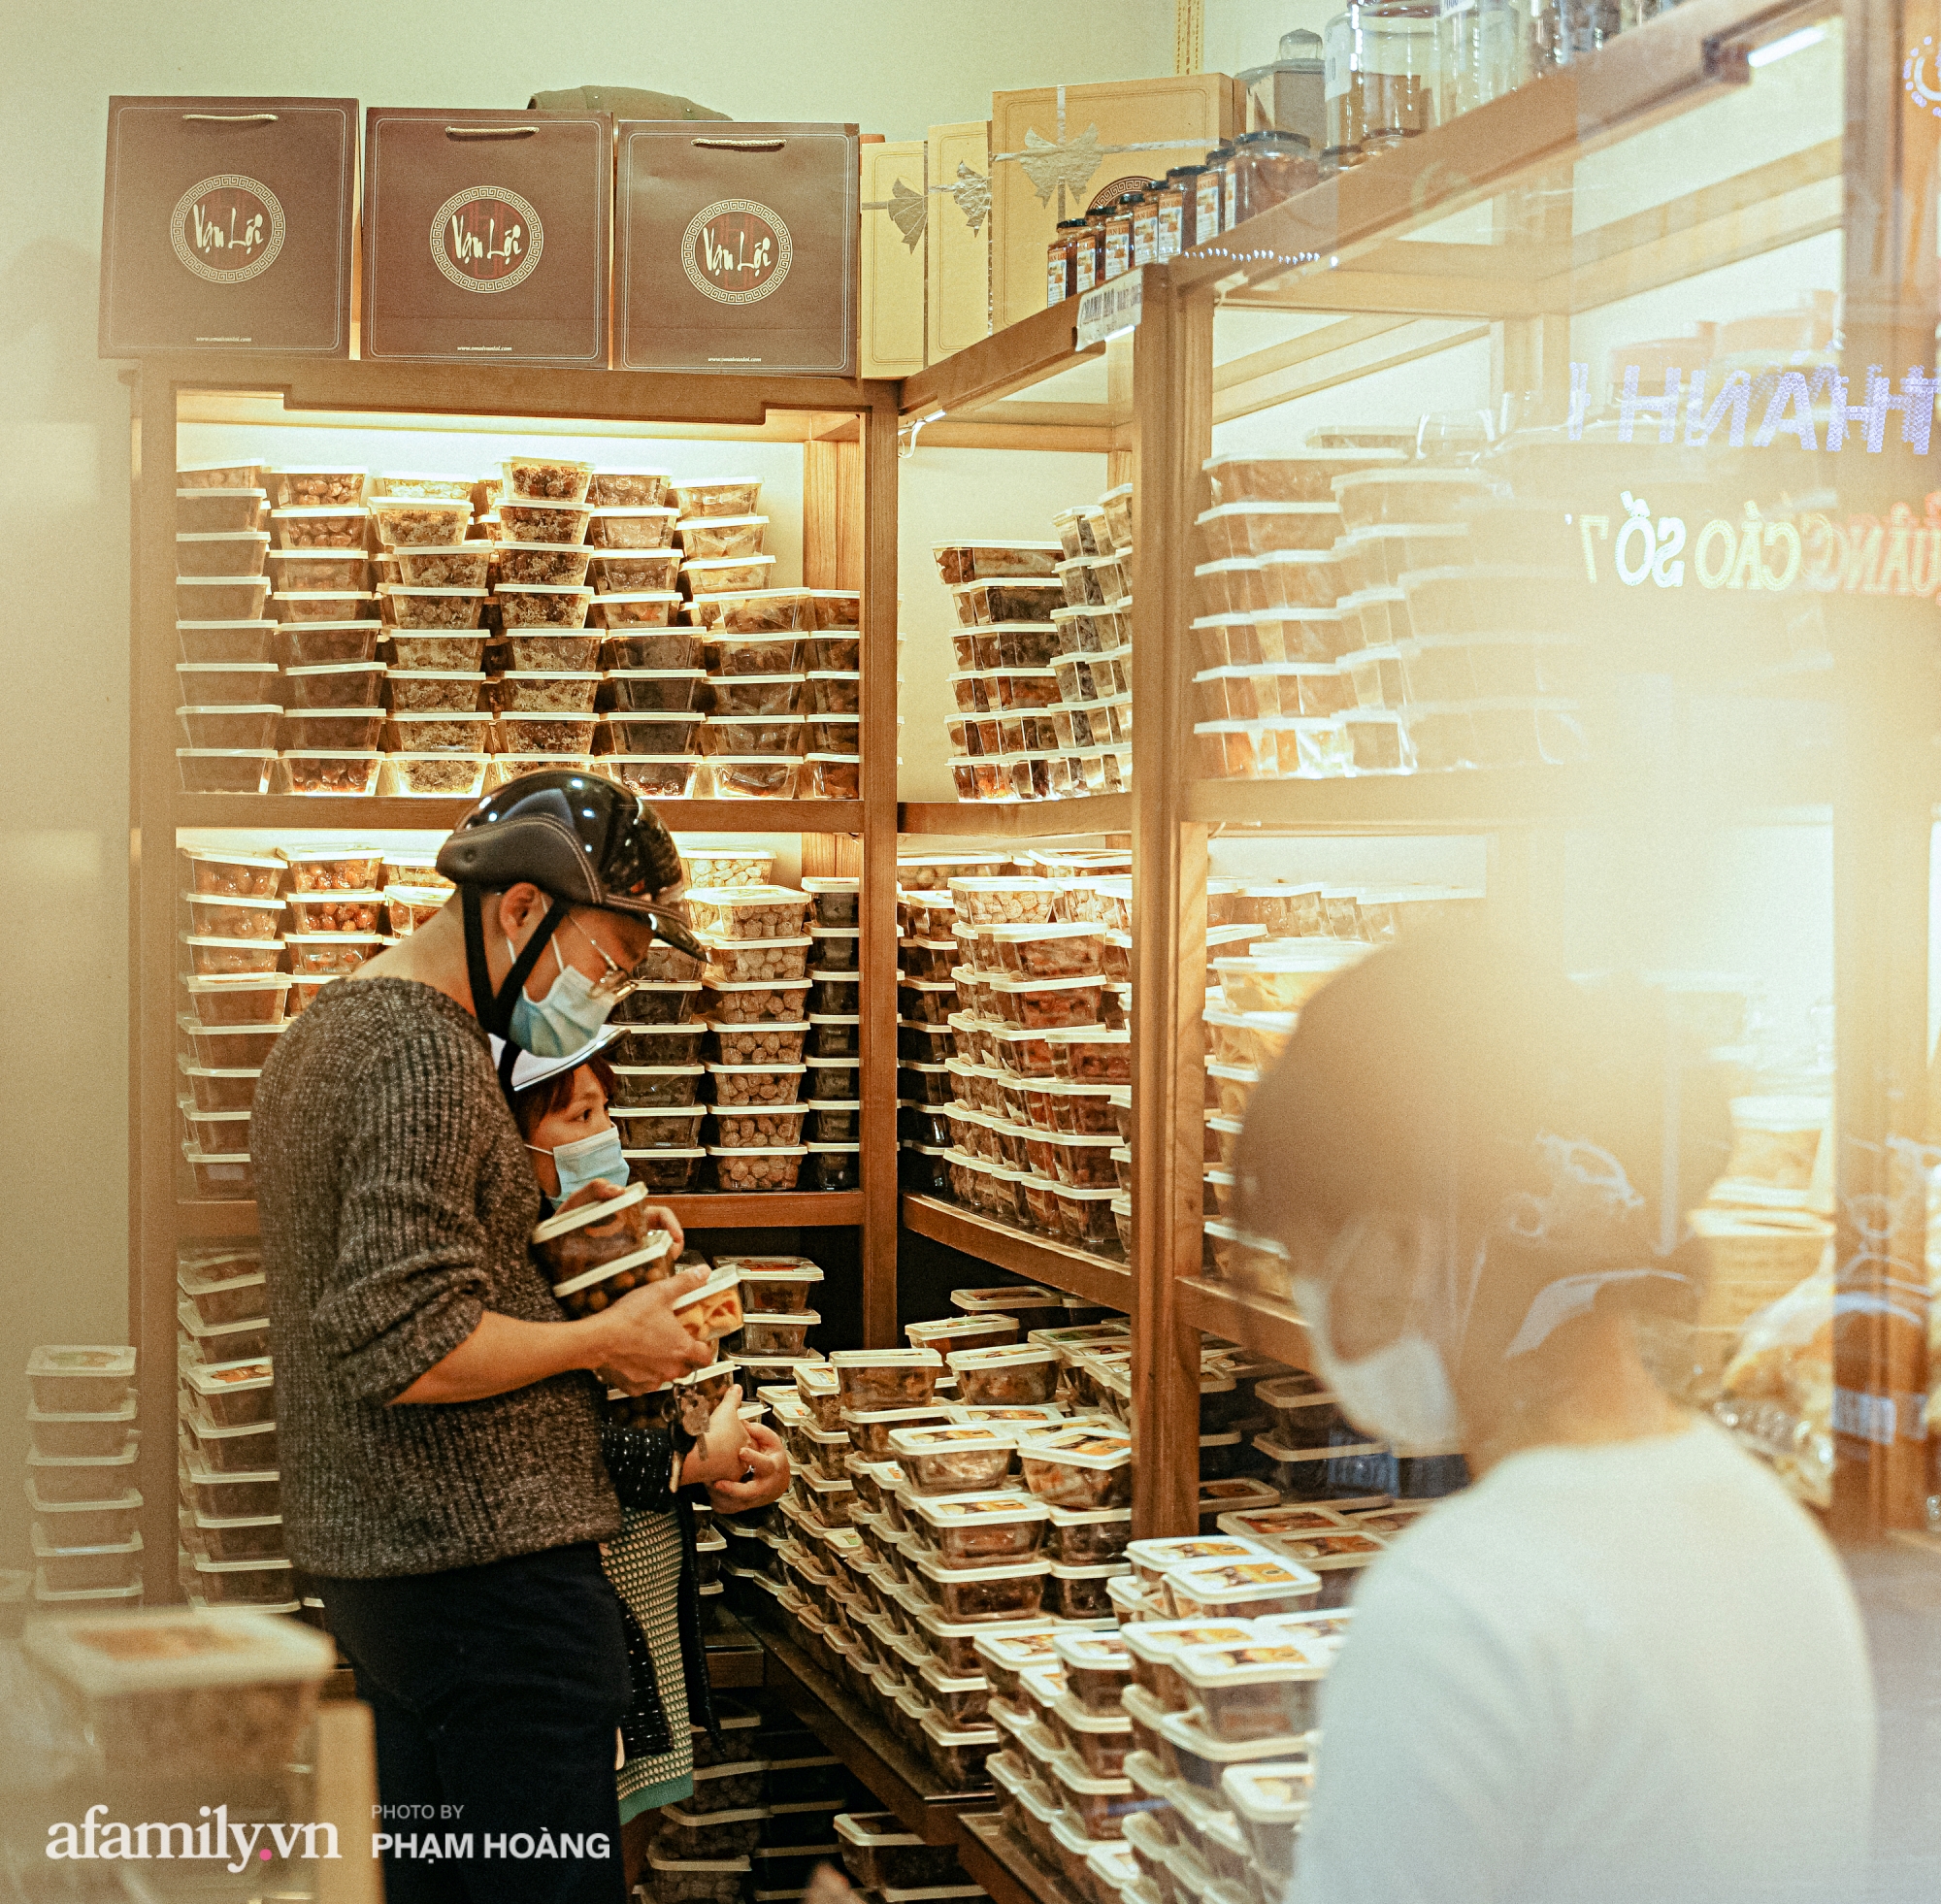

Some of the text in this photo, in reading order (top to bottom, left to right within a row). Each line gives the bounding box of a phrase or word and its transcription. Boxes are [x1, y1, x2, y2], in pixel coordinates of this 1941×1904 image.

[193, 204, 224, 253] Vạn
[451, 214, 483, 264] Vạn
[703, 227, 733, 277] Vạn
